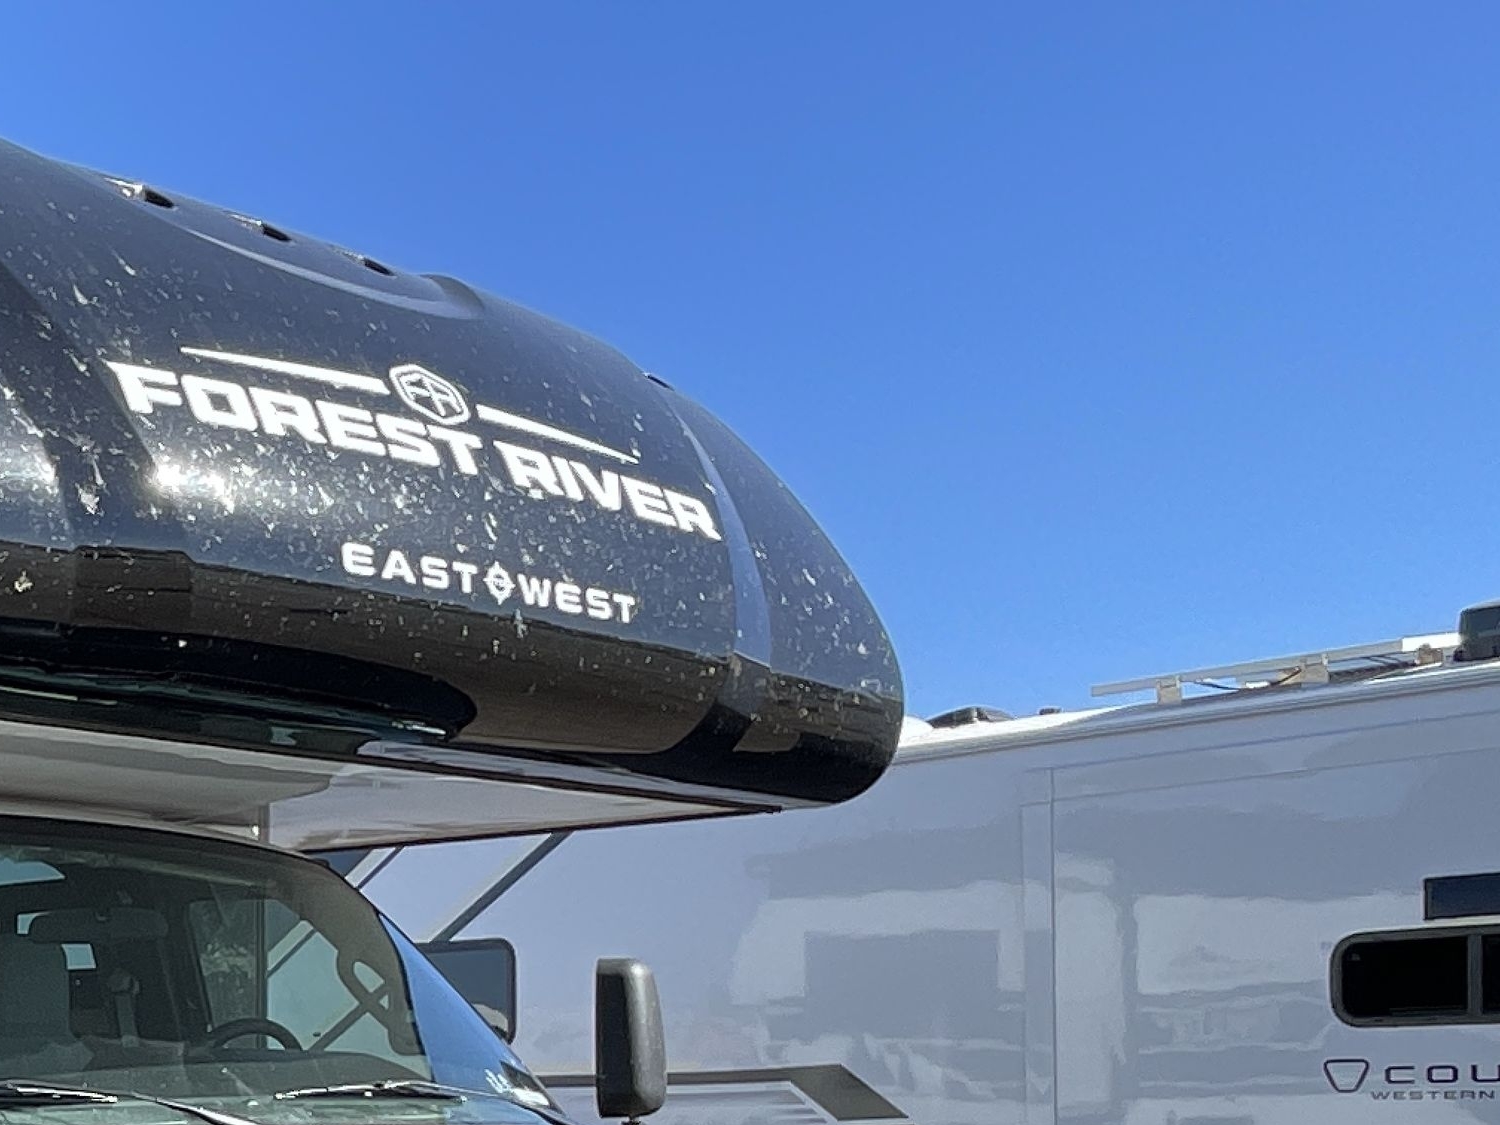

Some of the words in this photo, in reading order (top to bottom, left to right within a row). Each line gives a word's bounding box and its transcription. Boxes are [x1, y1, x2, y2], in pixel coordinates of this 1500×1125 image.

[105, 361, 482, 475] FOREST
[493, 440, 722, 541] RIVER
[1371, 1089, 1495, 1101] WESTERN
